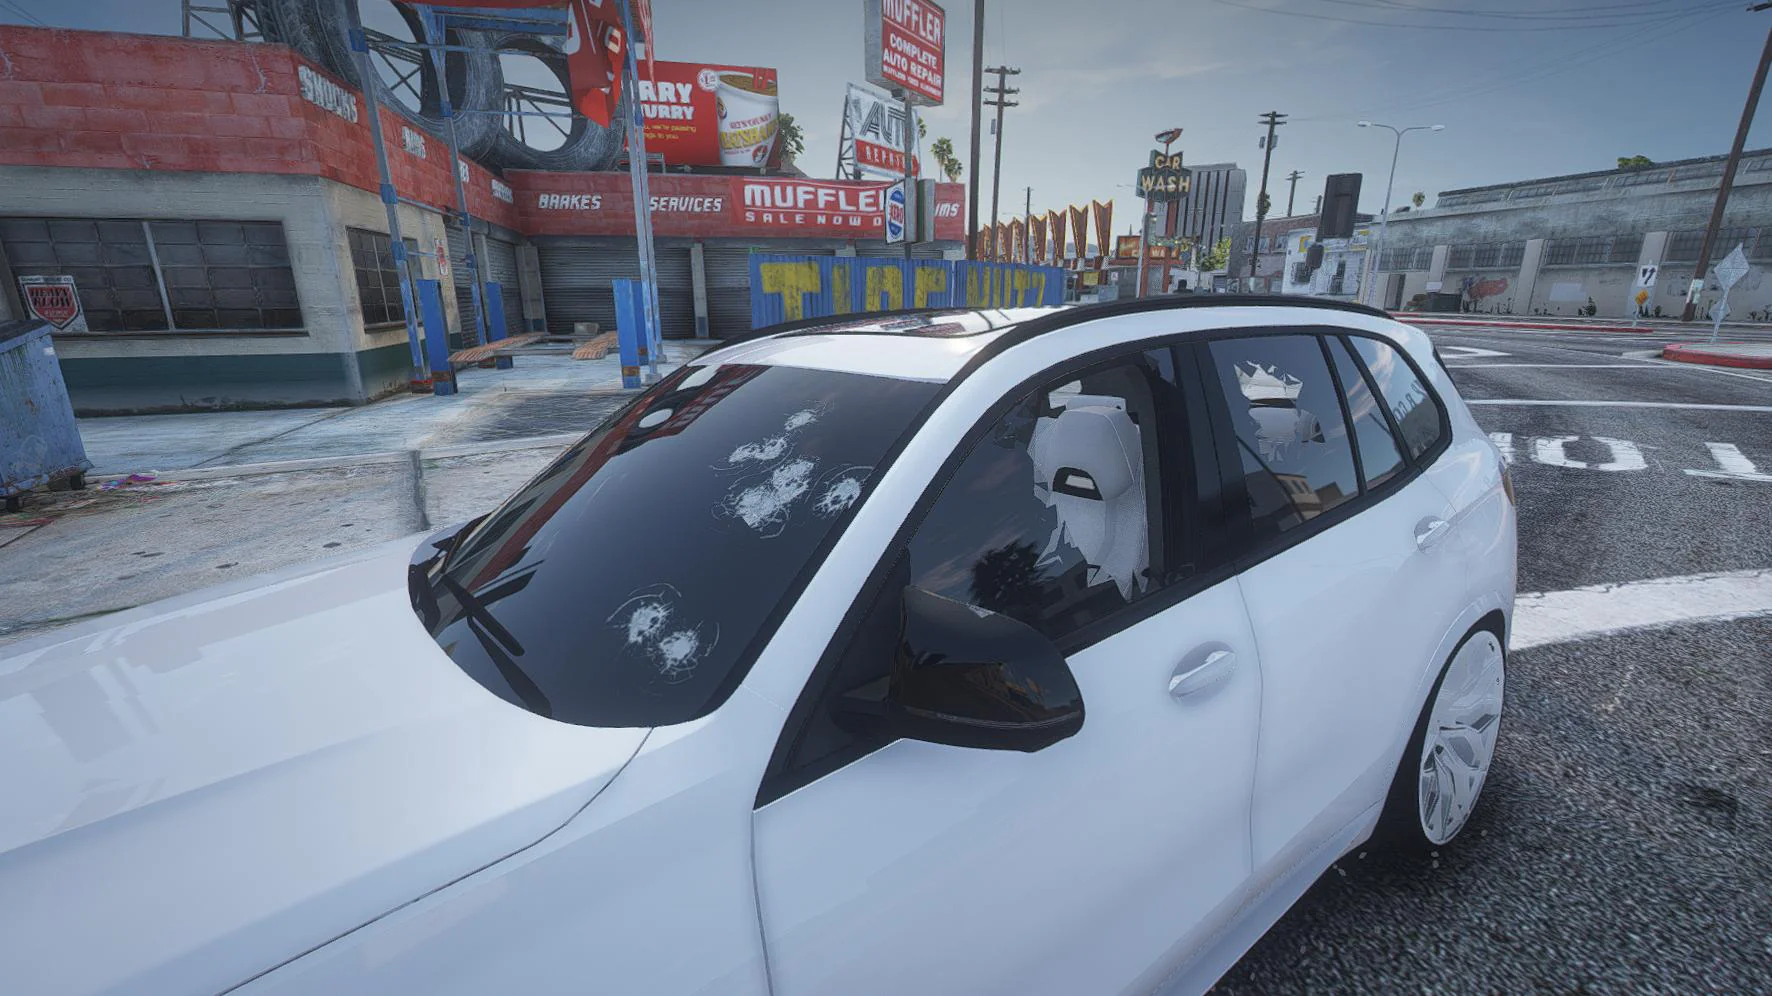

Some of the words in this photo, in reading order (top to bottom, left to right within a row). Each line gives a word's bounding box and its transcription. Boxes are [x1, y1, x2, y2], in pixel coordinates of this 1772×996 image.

[889, 33, 937, 69] COMPLETE
[883, 47, 908, 72] AUTO
[910, 61, 942, 87] REPAIR
[637, 80, 693, 103] ARY
[640, 103, 695, 121] URRY
[1154, 155, 1181, 171] CAR
[1141, 175, 1190, 193] WASH
[538, 193, 602, 210] BRAKES
[649, 196, 723, 212] SERVICES
[934, 202, 961, 218] IMS
[745, 211, 806, 225] SALE
[817, 213, 861, 227] NOW
